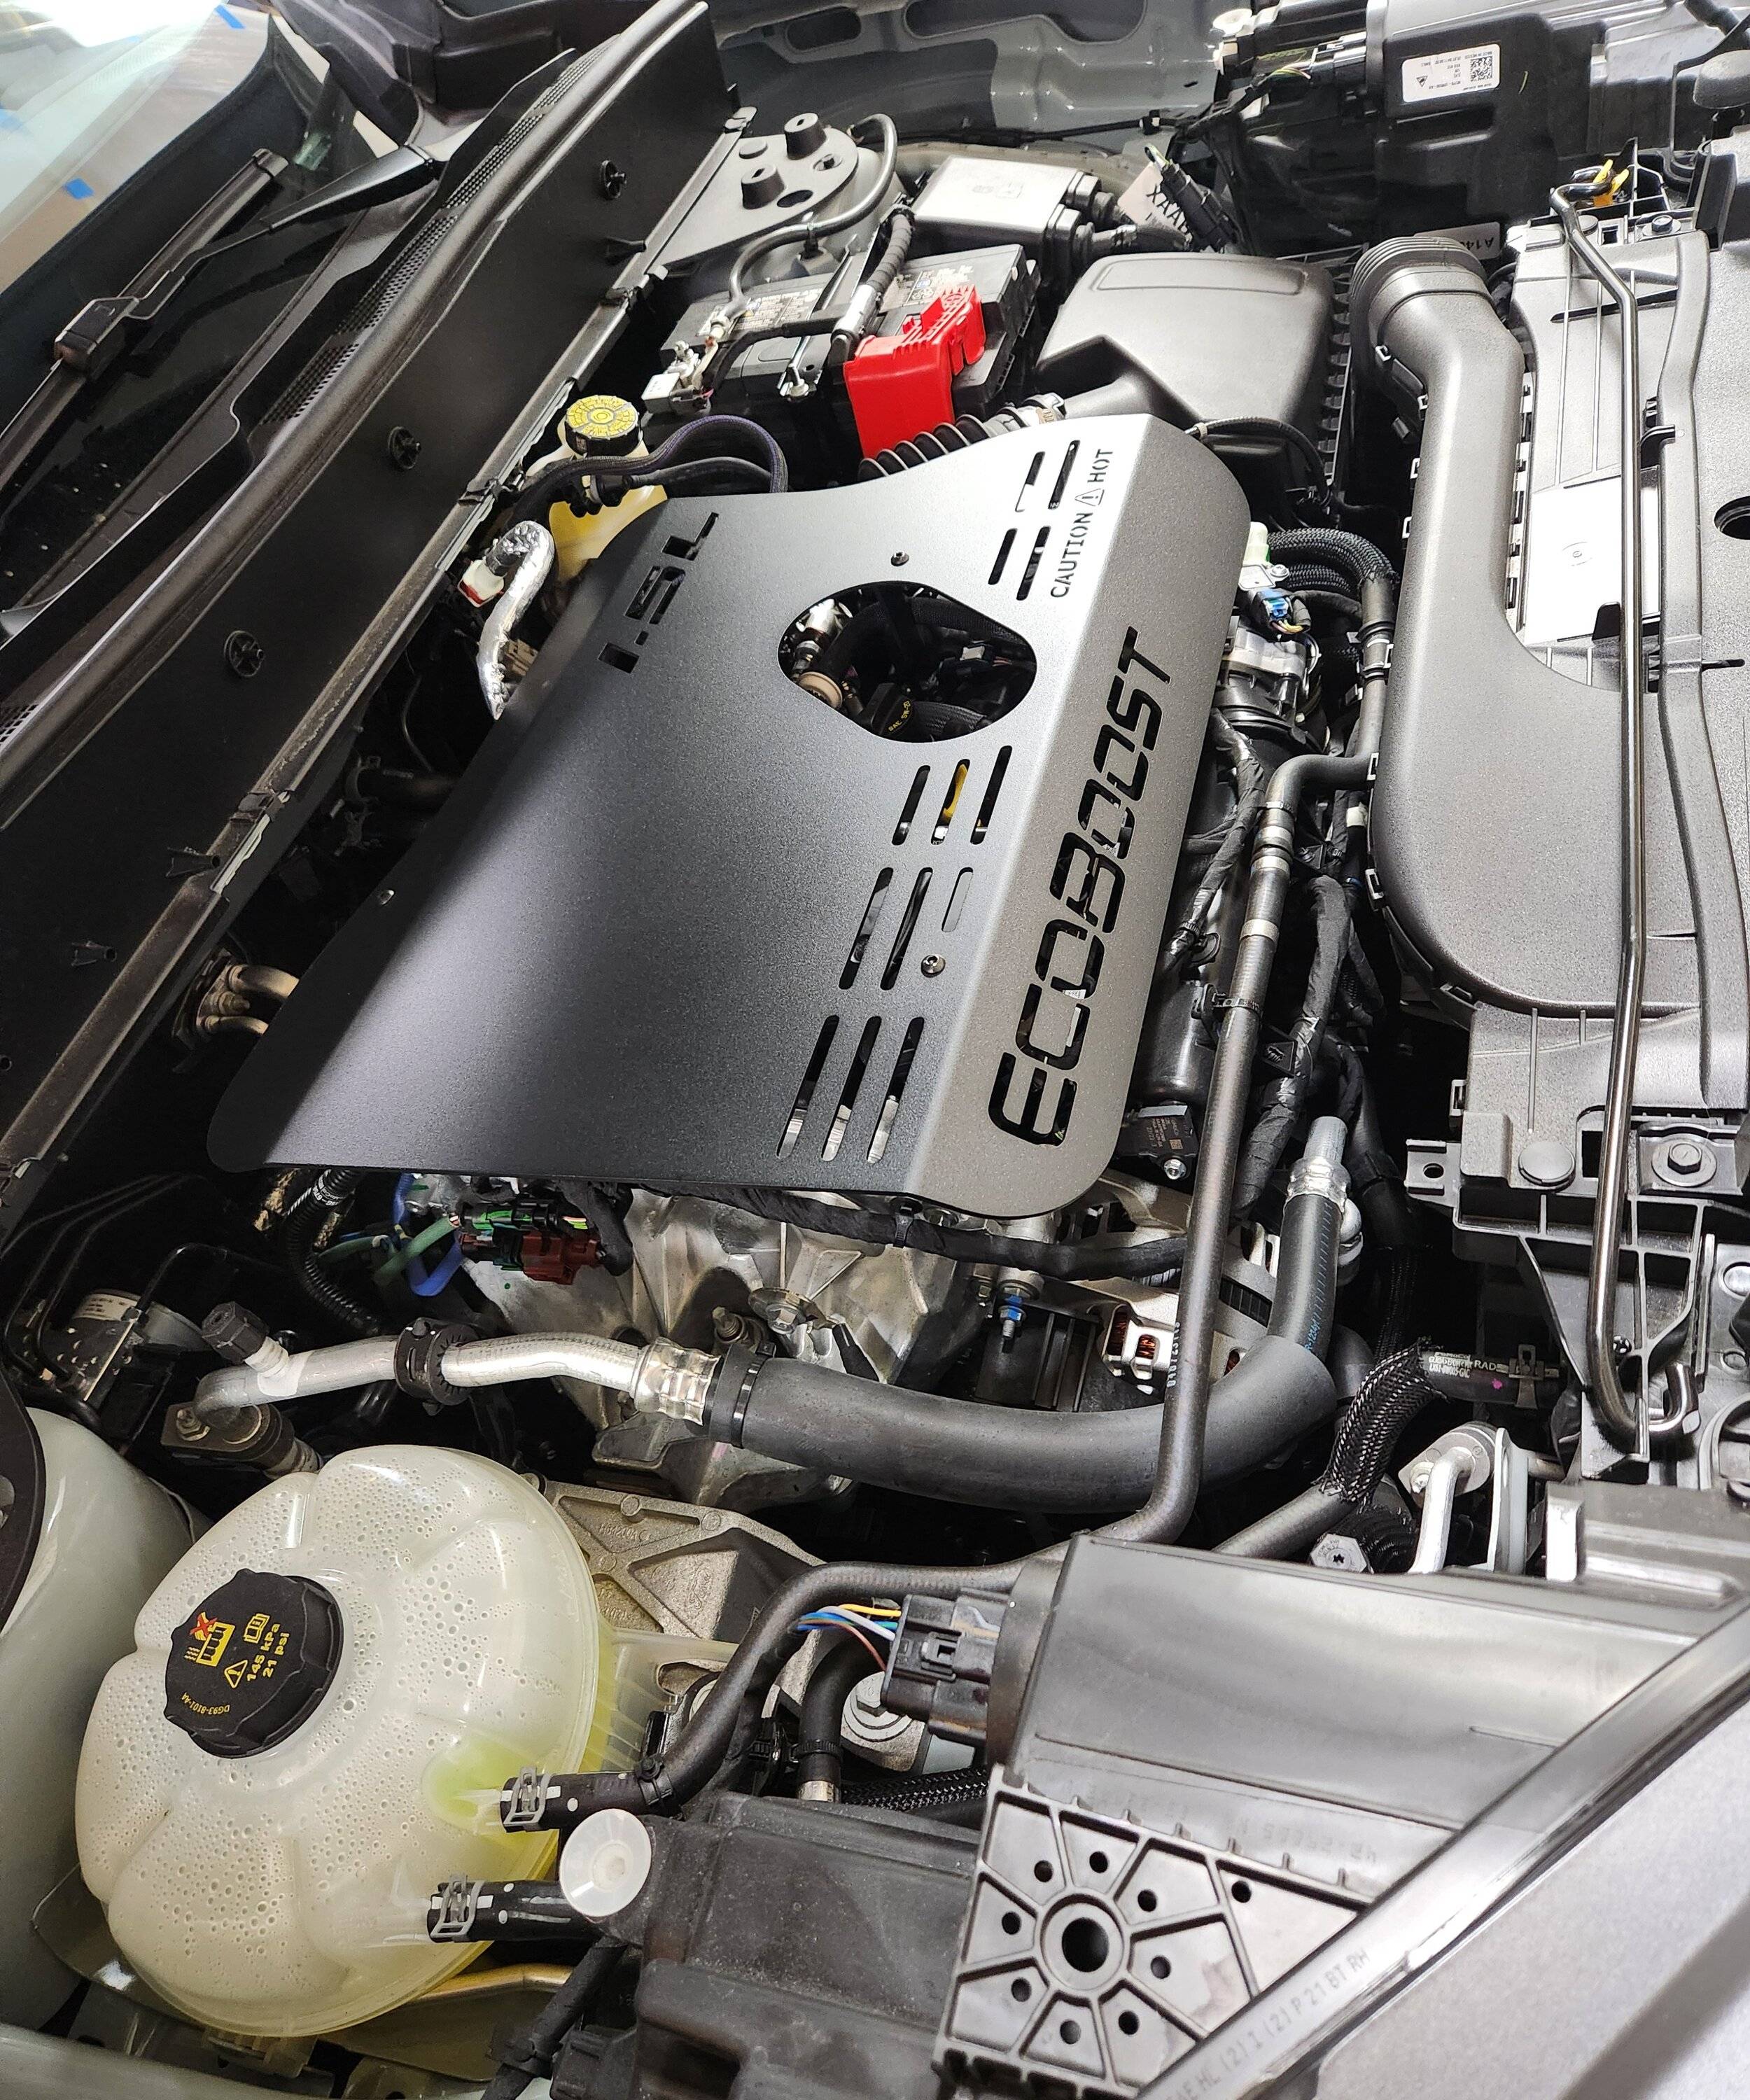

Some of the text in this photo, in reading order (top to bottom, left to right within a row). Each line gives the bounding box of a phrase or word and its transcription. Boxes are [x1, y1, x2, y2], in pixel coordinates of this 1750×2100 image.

[1050, 448, 1114, 598] CAUTION HOT
[987, 625, 1171, 1147] ECOBOOST
[1474, 1359, 1497, 1371] RAD
[246, 1623, 281, 1681] 145 kPa
[262, 1632, 290, 1678] 21 psi
[181, 1691, 230, 1715] DG93-8101-AA
[1291, 1997, 1303, 2015] P
[1303, 1982, 1324, 2006] 21
[1348, 1949, 1371, 1970] RH
